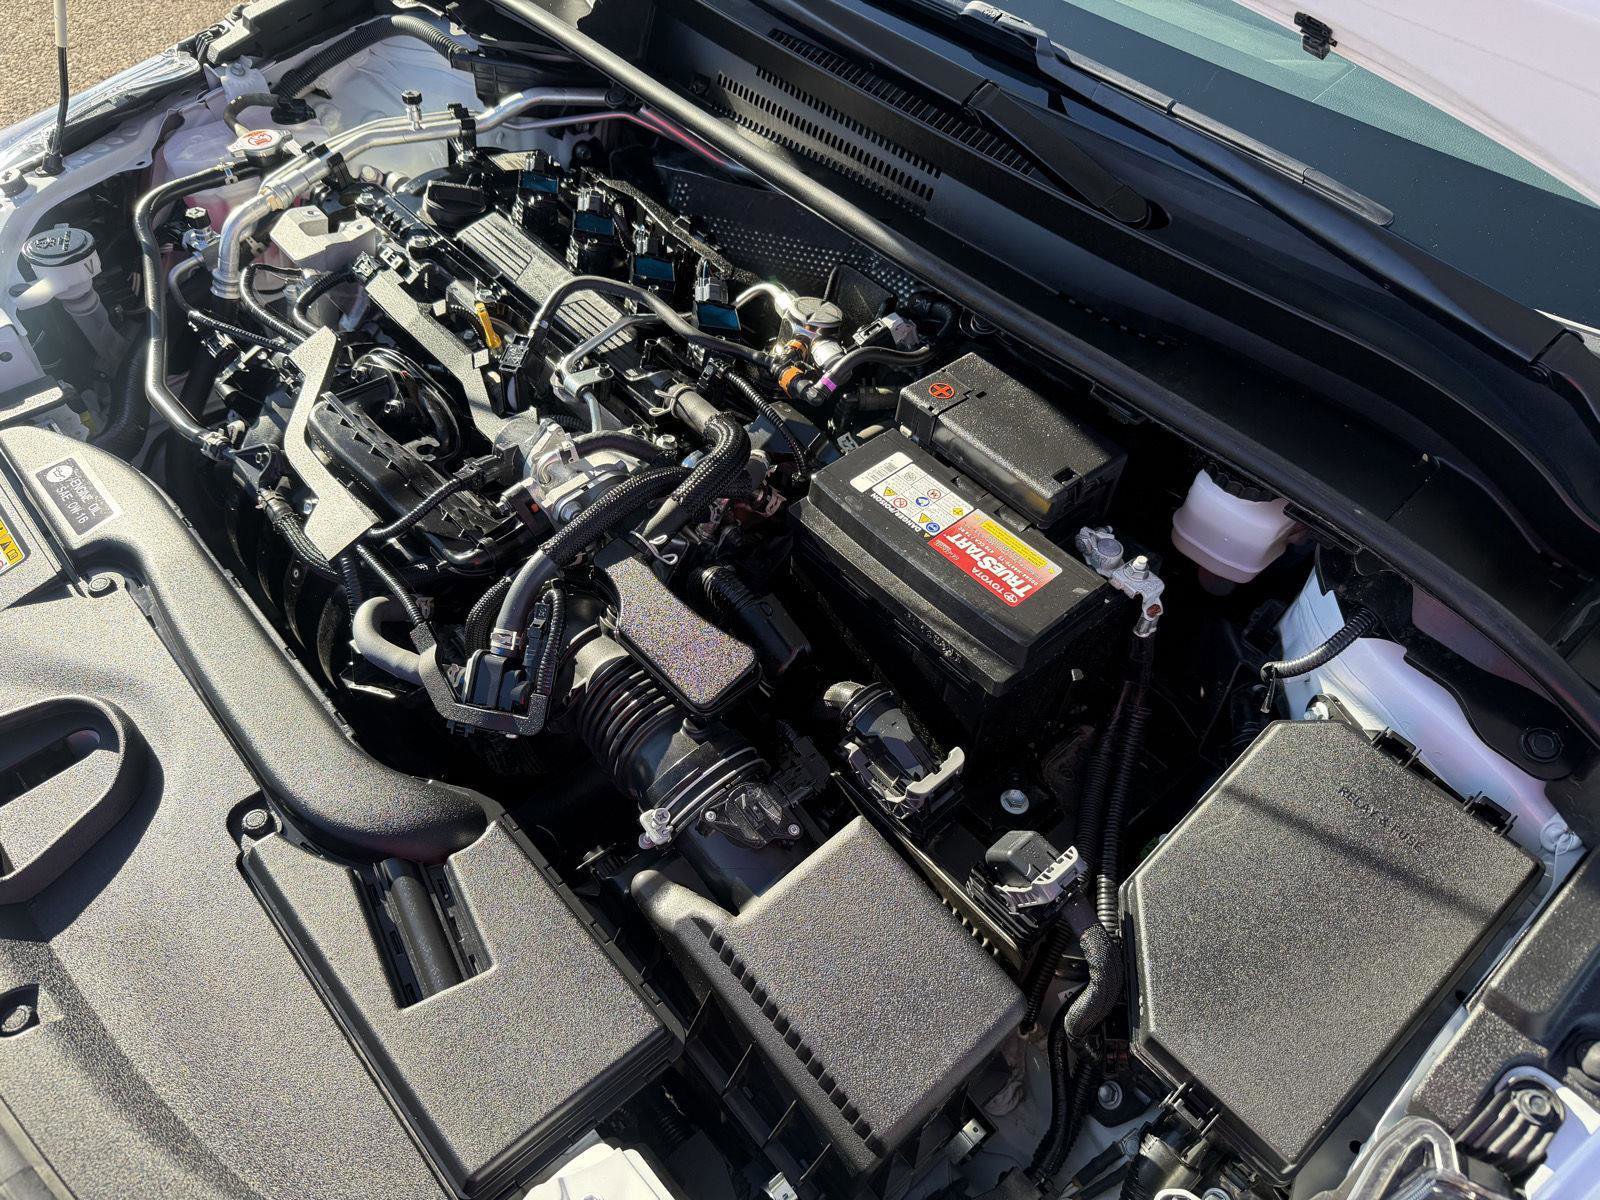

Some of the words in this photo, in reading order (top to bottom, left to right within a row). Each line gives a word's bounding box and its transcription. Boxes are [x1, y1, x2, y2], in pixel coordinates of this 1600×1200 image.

[56, 485, 73, 502] SAE
[67, 501, 89, 524] 0W-16
[69, 478, 94, 503] ENGINE
[88, 503, 101, 516] OIL
[870, 493, 922, 533] DANGER/POISON
[971, 566, 1003, 592] TOYOTA
[1338, 786, 1379, 817] RELAY
[1390, 823, 1422, 852] FUSE
